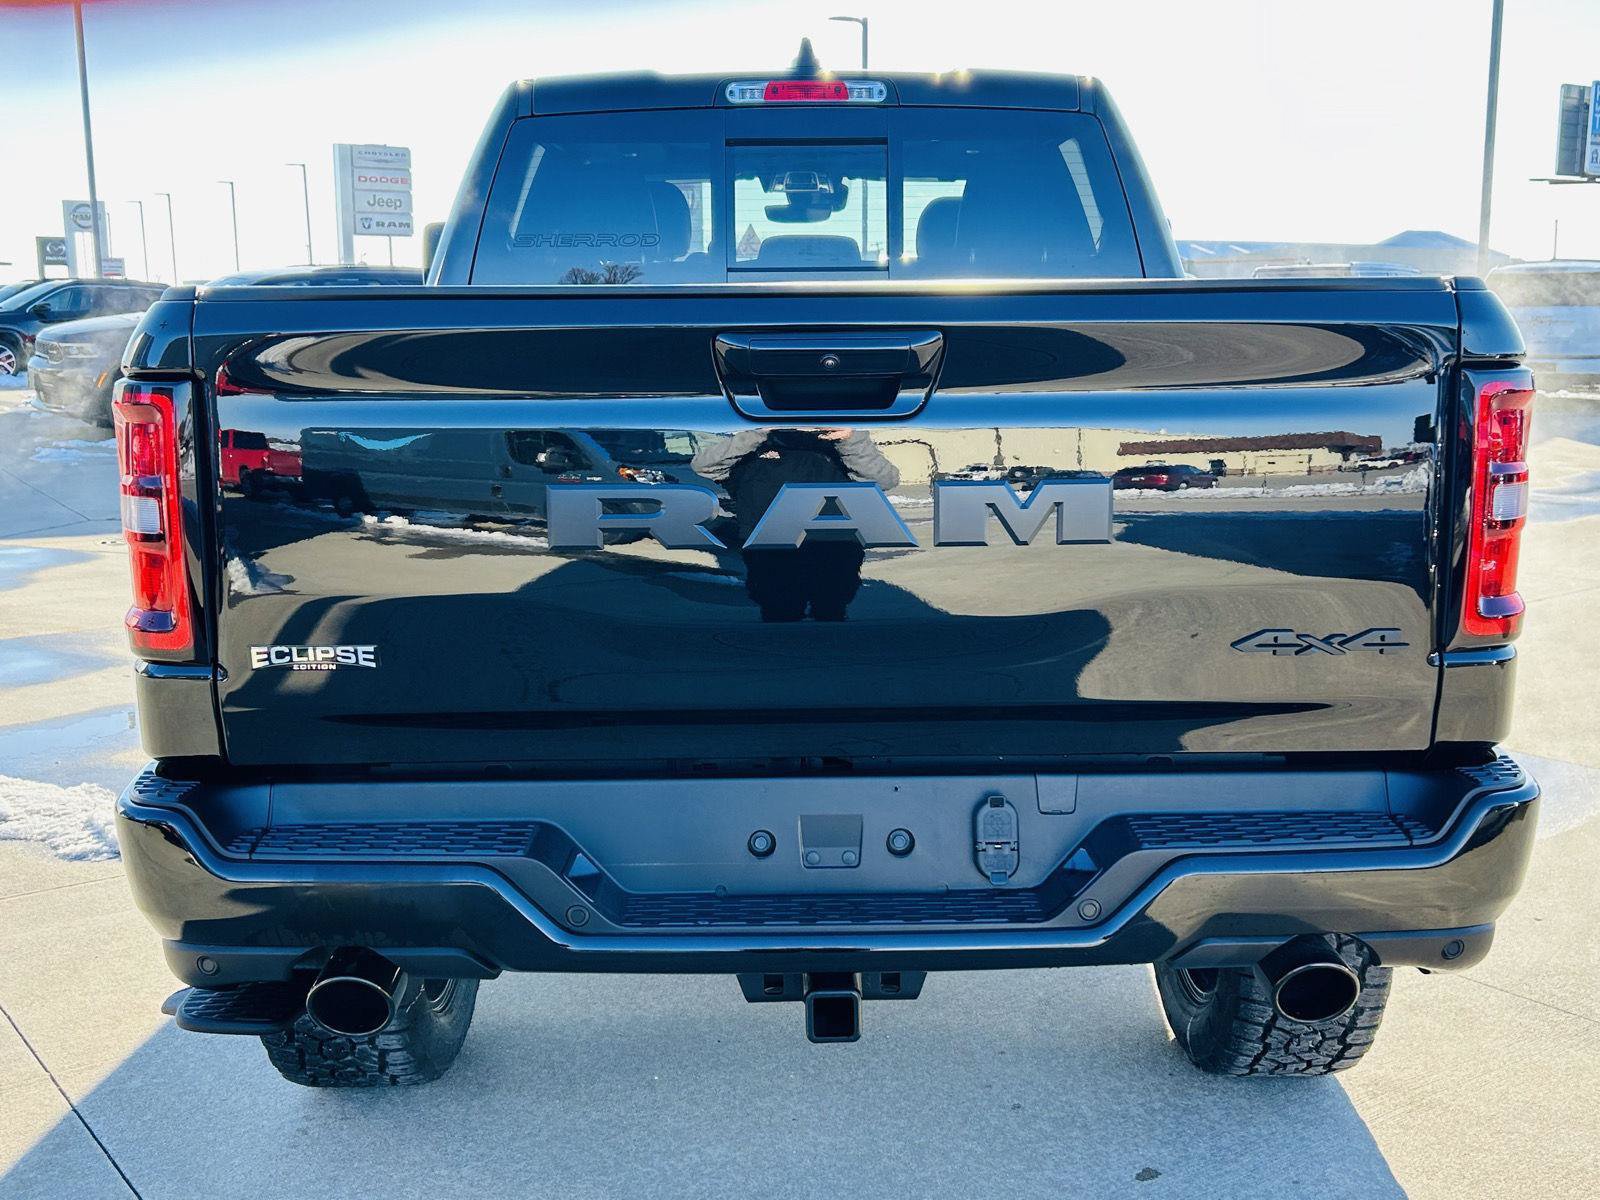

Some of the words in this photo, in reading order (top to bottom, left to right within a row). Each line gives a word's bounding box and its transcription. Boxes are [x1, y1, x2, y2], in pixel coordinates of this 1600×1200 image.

[358, 175, 408, 185] DODGE
[366, 194, 402, 210] Jeep
[375, 221, 411, 229] RAM
[513, 233, 661, 248] SHERROD
[546, 478, 1114, 550] RAM
[250, 645, 377, 669] ECLIPSE
